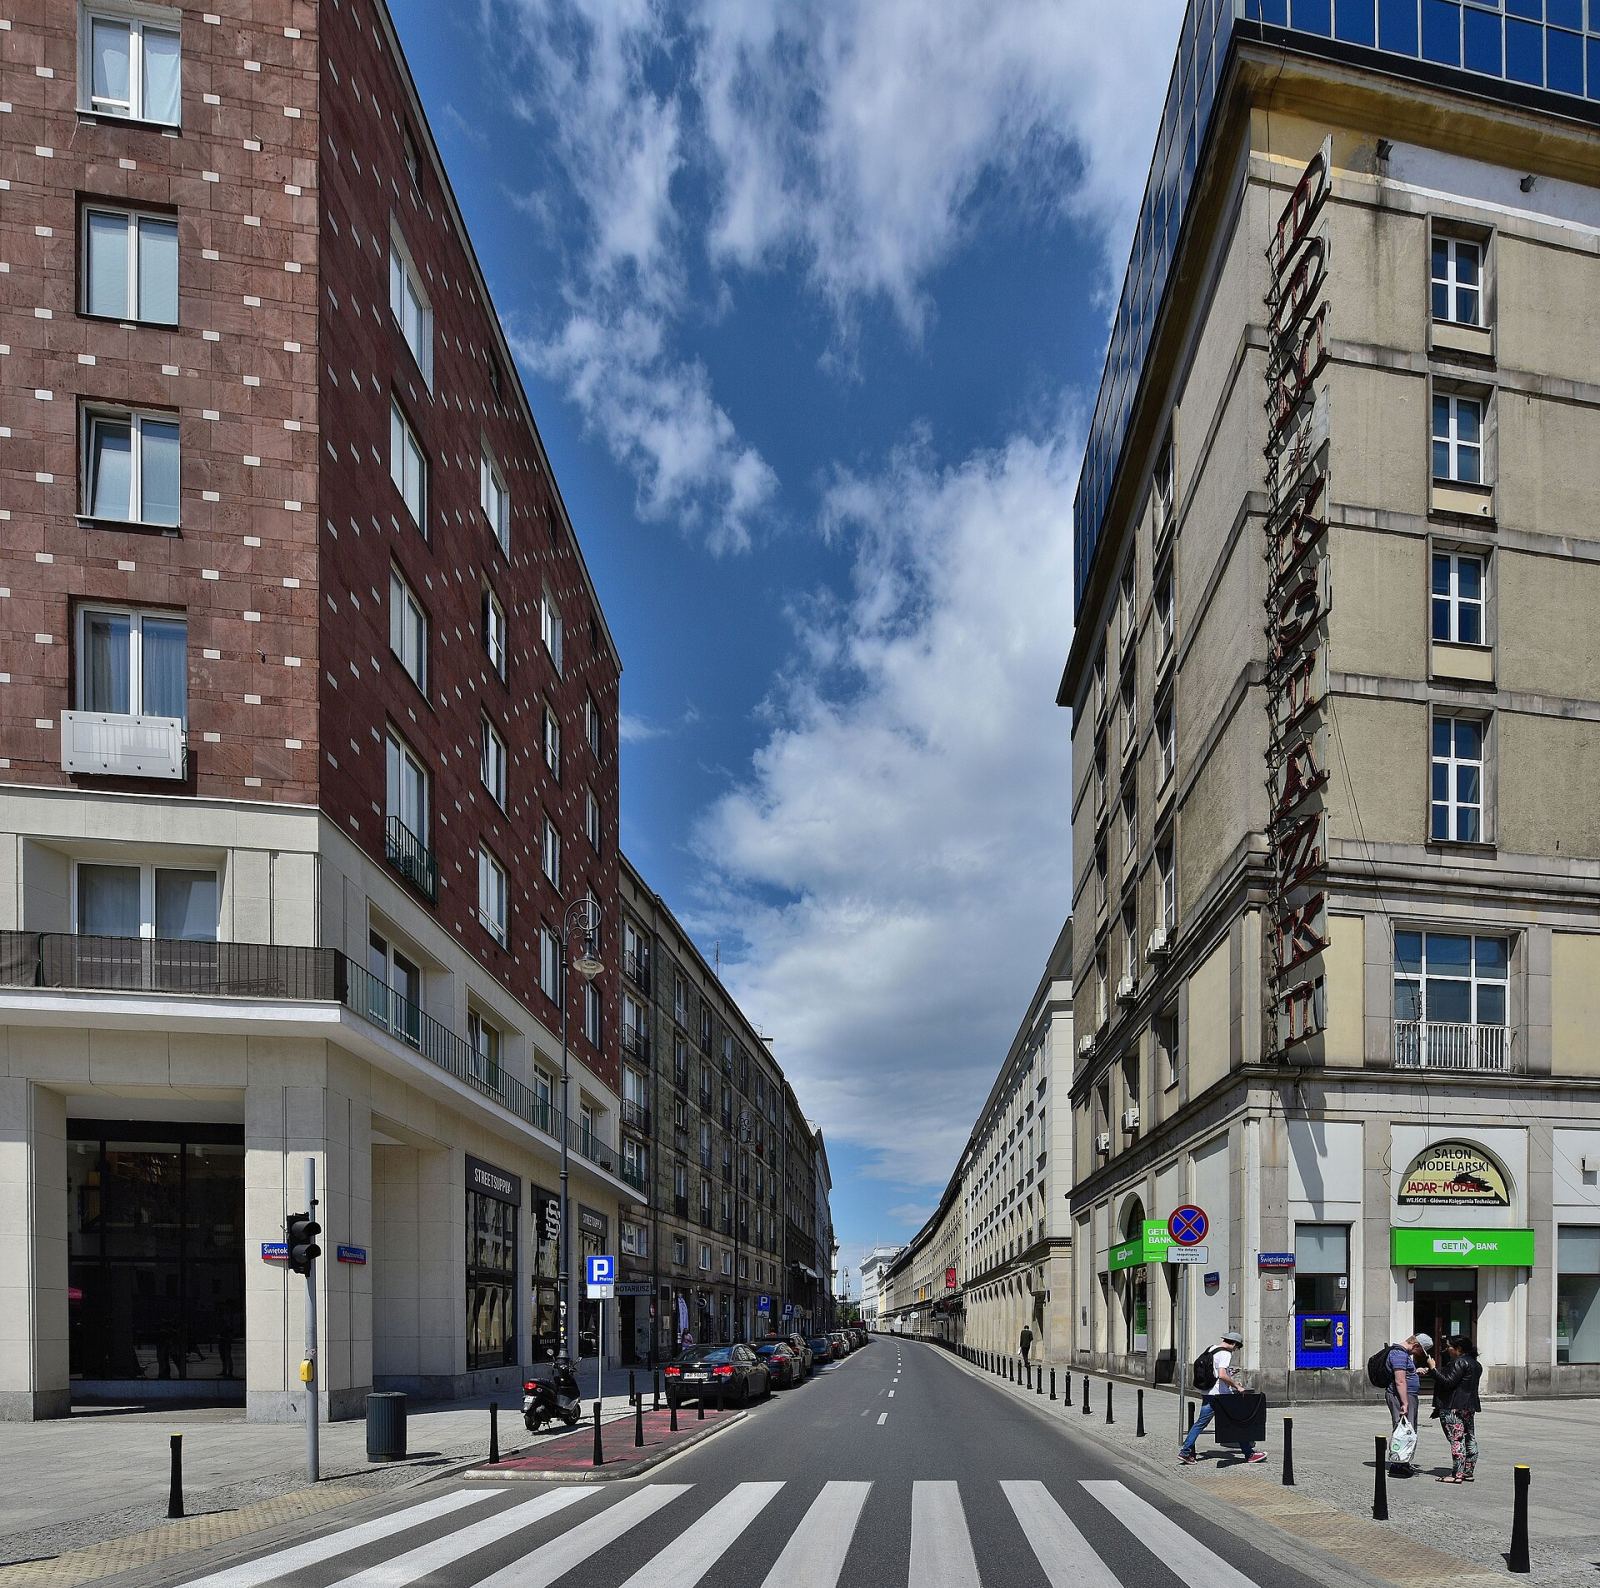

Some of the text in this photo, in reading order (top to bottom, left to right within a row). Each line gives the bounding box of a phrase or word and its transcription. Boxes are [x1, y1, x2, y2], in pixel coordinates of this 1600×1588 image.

[1434, 1148, 1472, 1159] SALON
[1416, 1160, 1489, 1172] MODELARSKI
[1406, 1181, 1481, 1194] JADAR-MODEL
[263, 1246, 288, 1255] Świętok
[1441, 1242, 1498, 1251] GET IN BANK
[593, 1260, 609, 1281] P
[616, 1284, 650, 1292] NOTARIUSZ
[760, 1297, 768, 1306] P
[785, 1304, 793, 1314] P
